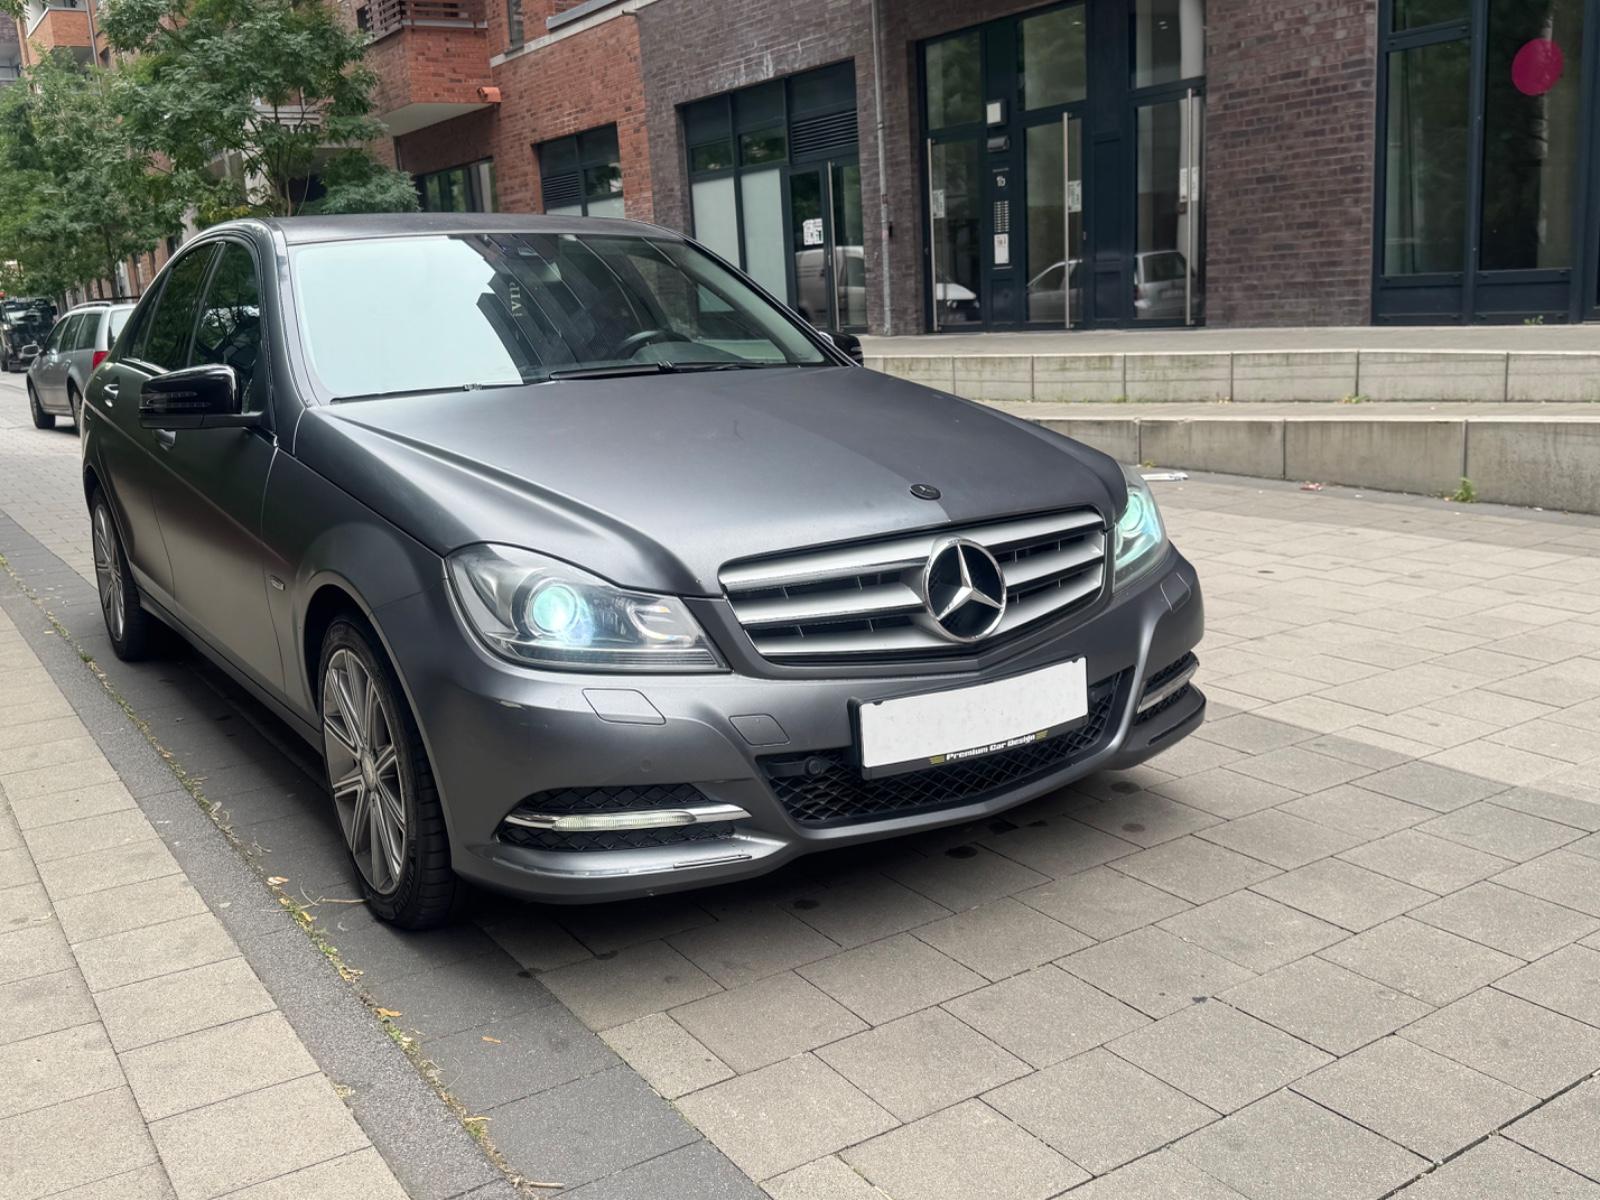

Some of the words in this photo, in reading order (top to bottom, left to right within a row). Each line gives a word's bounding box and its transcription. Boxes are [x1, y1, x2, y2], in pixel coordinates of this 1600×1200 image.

[946, 746, 988, 761] Premium
[989, 742, 1006, 751] Car
[1007, 734, 1035, 747] Design
